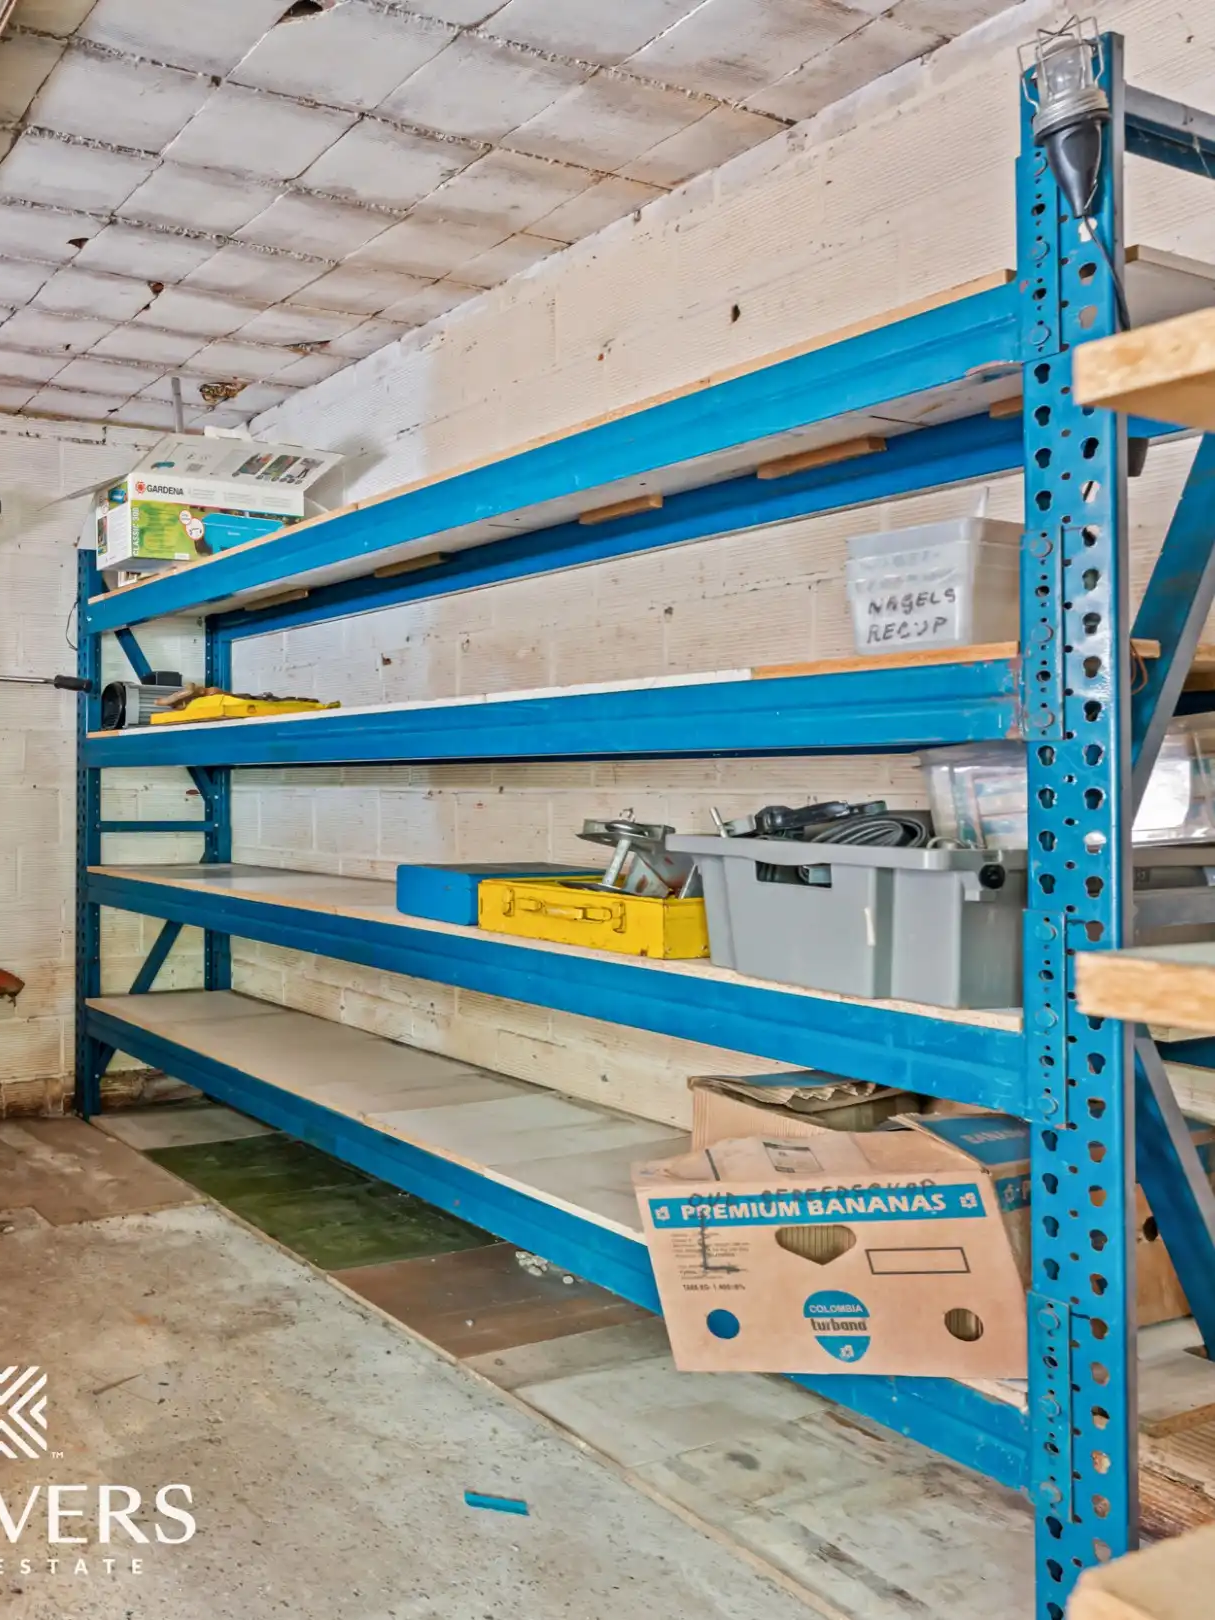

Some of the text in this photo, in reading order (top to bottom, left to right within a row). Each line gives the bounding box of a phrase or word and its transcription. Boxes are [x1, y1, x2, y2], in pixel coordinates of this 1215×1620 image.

[146, 484, 184, 496] GARDENA
[868, 587, 956, 615] NAGELS
[867, 616, 948, 644] RECUP
[680, 1193, 947, 1221] PREMIUM BANANAS
[809, 1304, 864, 1313] COLOMBIA
[810, 1318, 868, 1331] turbana
